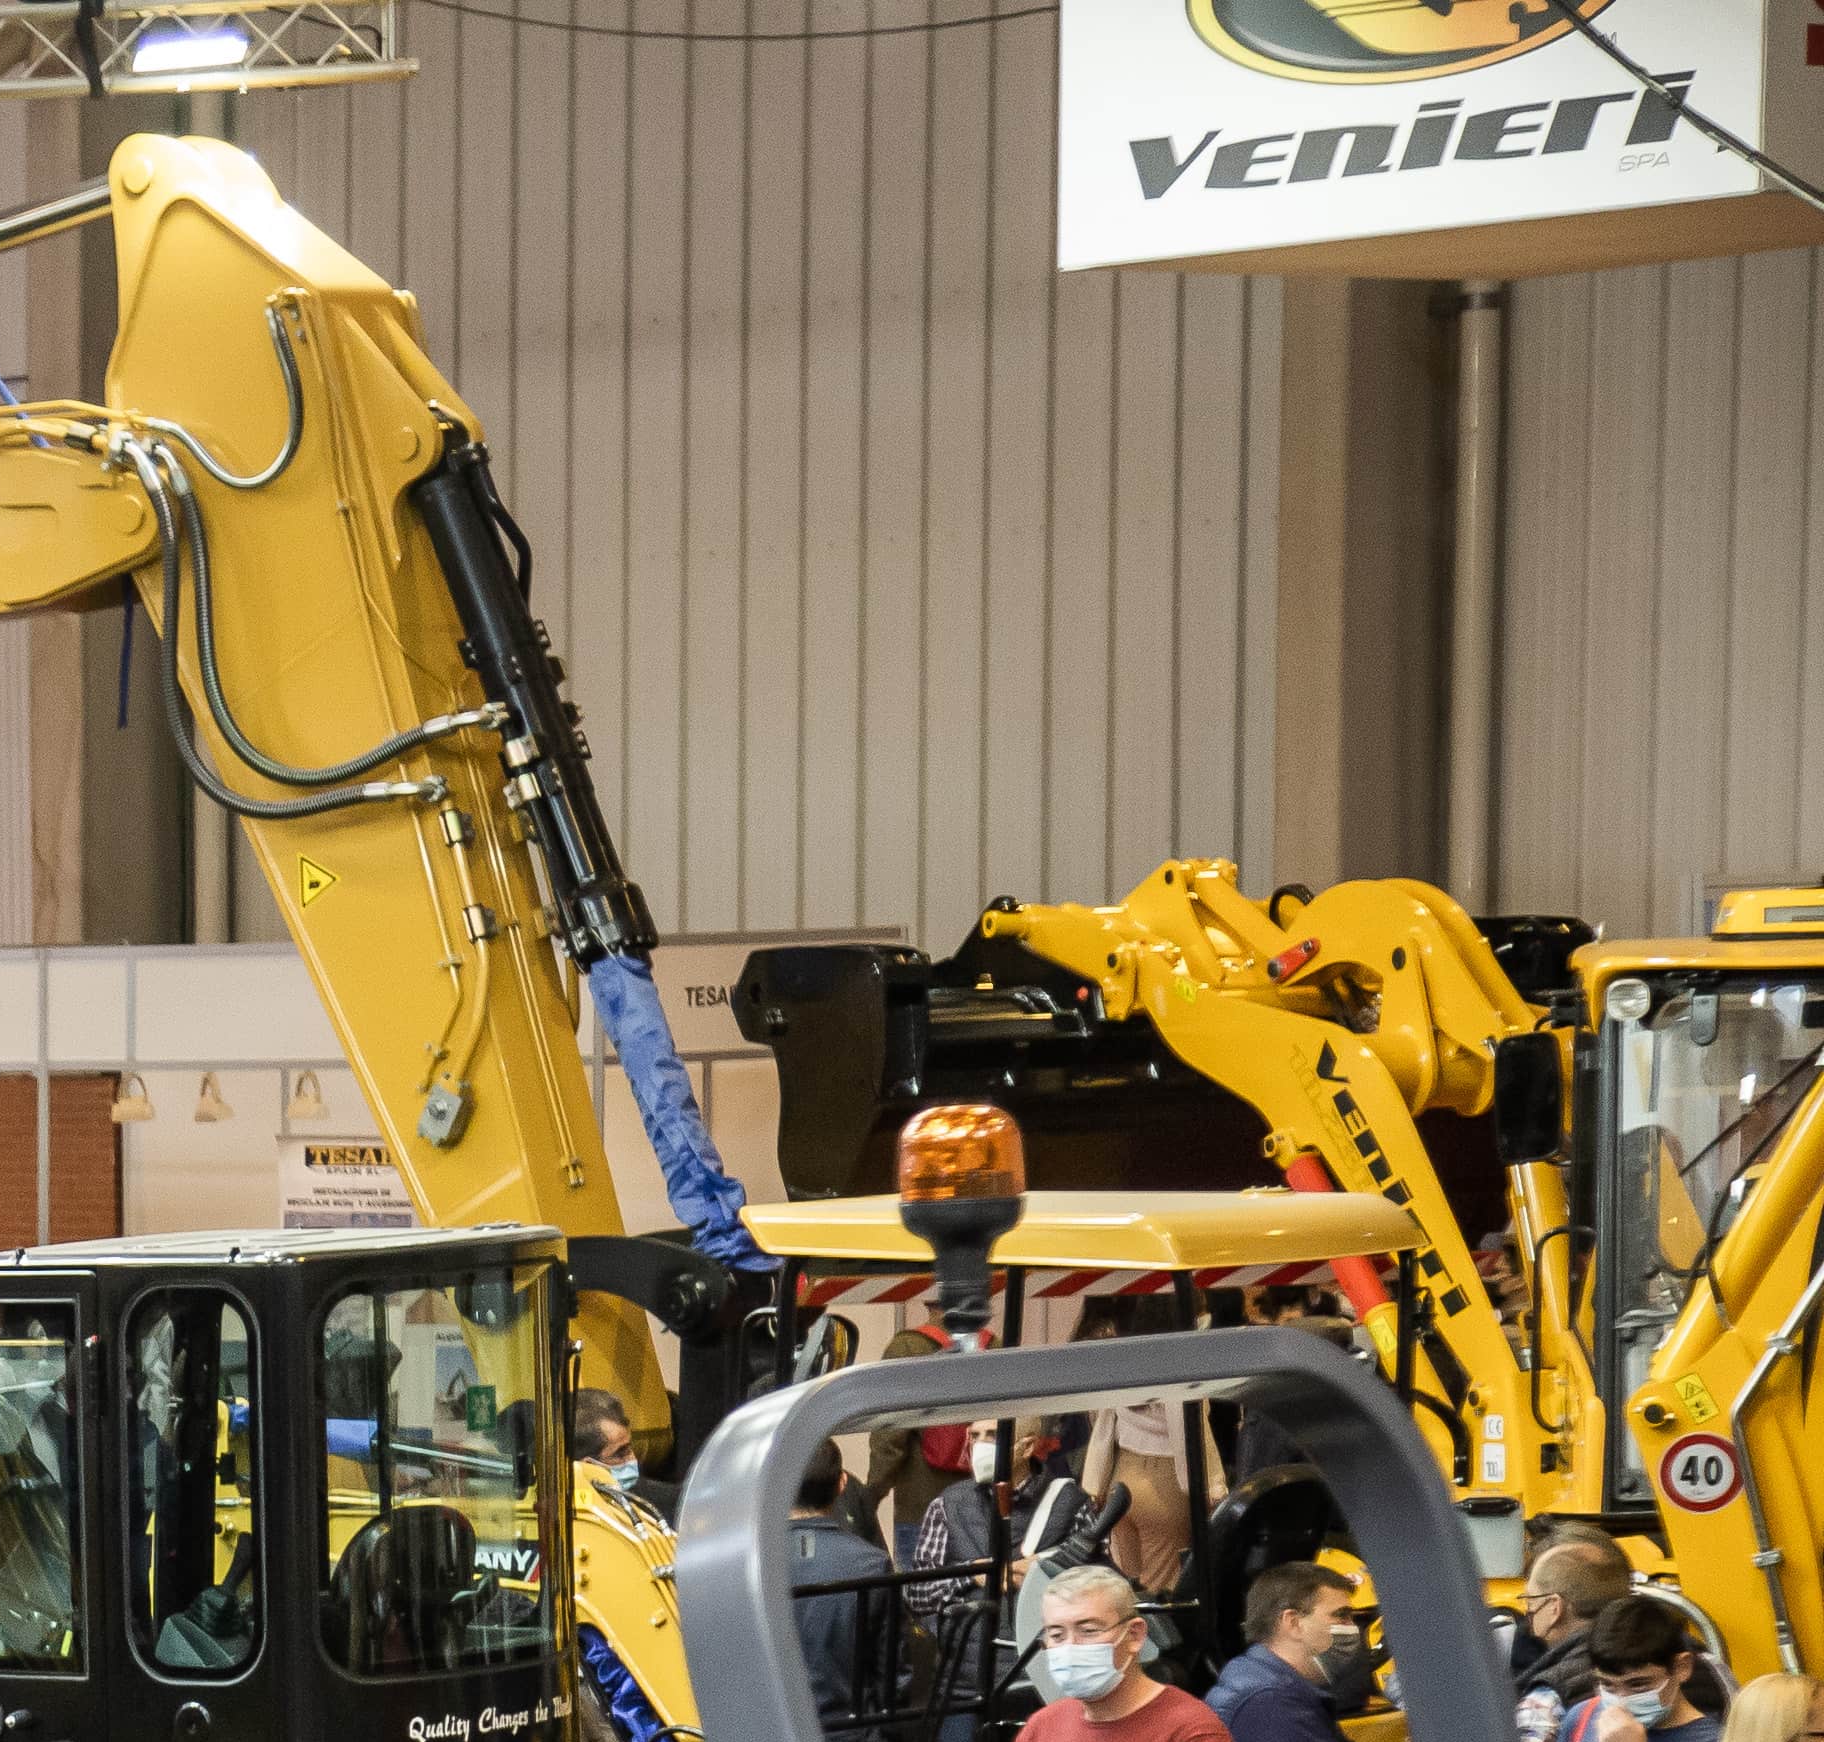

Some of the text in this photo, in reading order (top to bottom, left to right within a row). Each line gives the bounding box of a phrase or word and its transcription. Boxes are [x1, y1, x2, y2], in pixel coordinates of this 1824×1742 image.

[1618, 151, 1671, 174] SPA
[1679, 1455, 1724, 1486] 40
[473, 1549, 533, 1572] ANY
[409, 1714, 470, 1742] Quality
[478, 1706, 529, 1735] Changes
[535, 1697, 549, 1723] the
